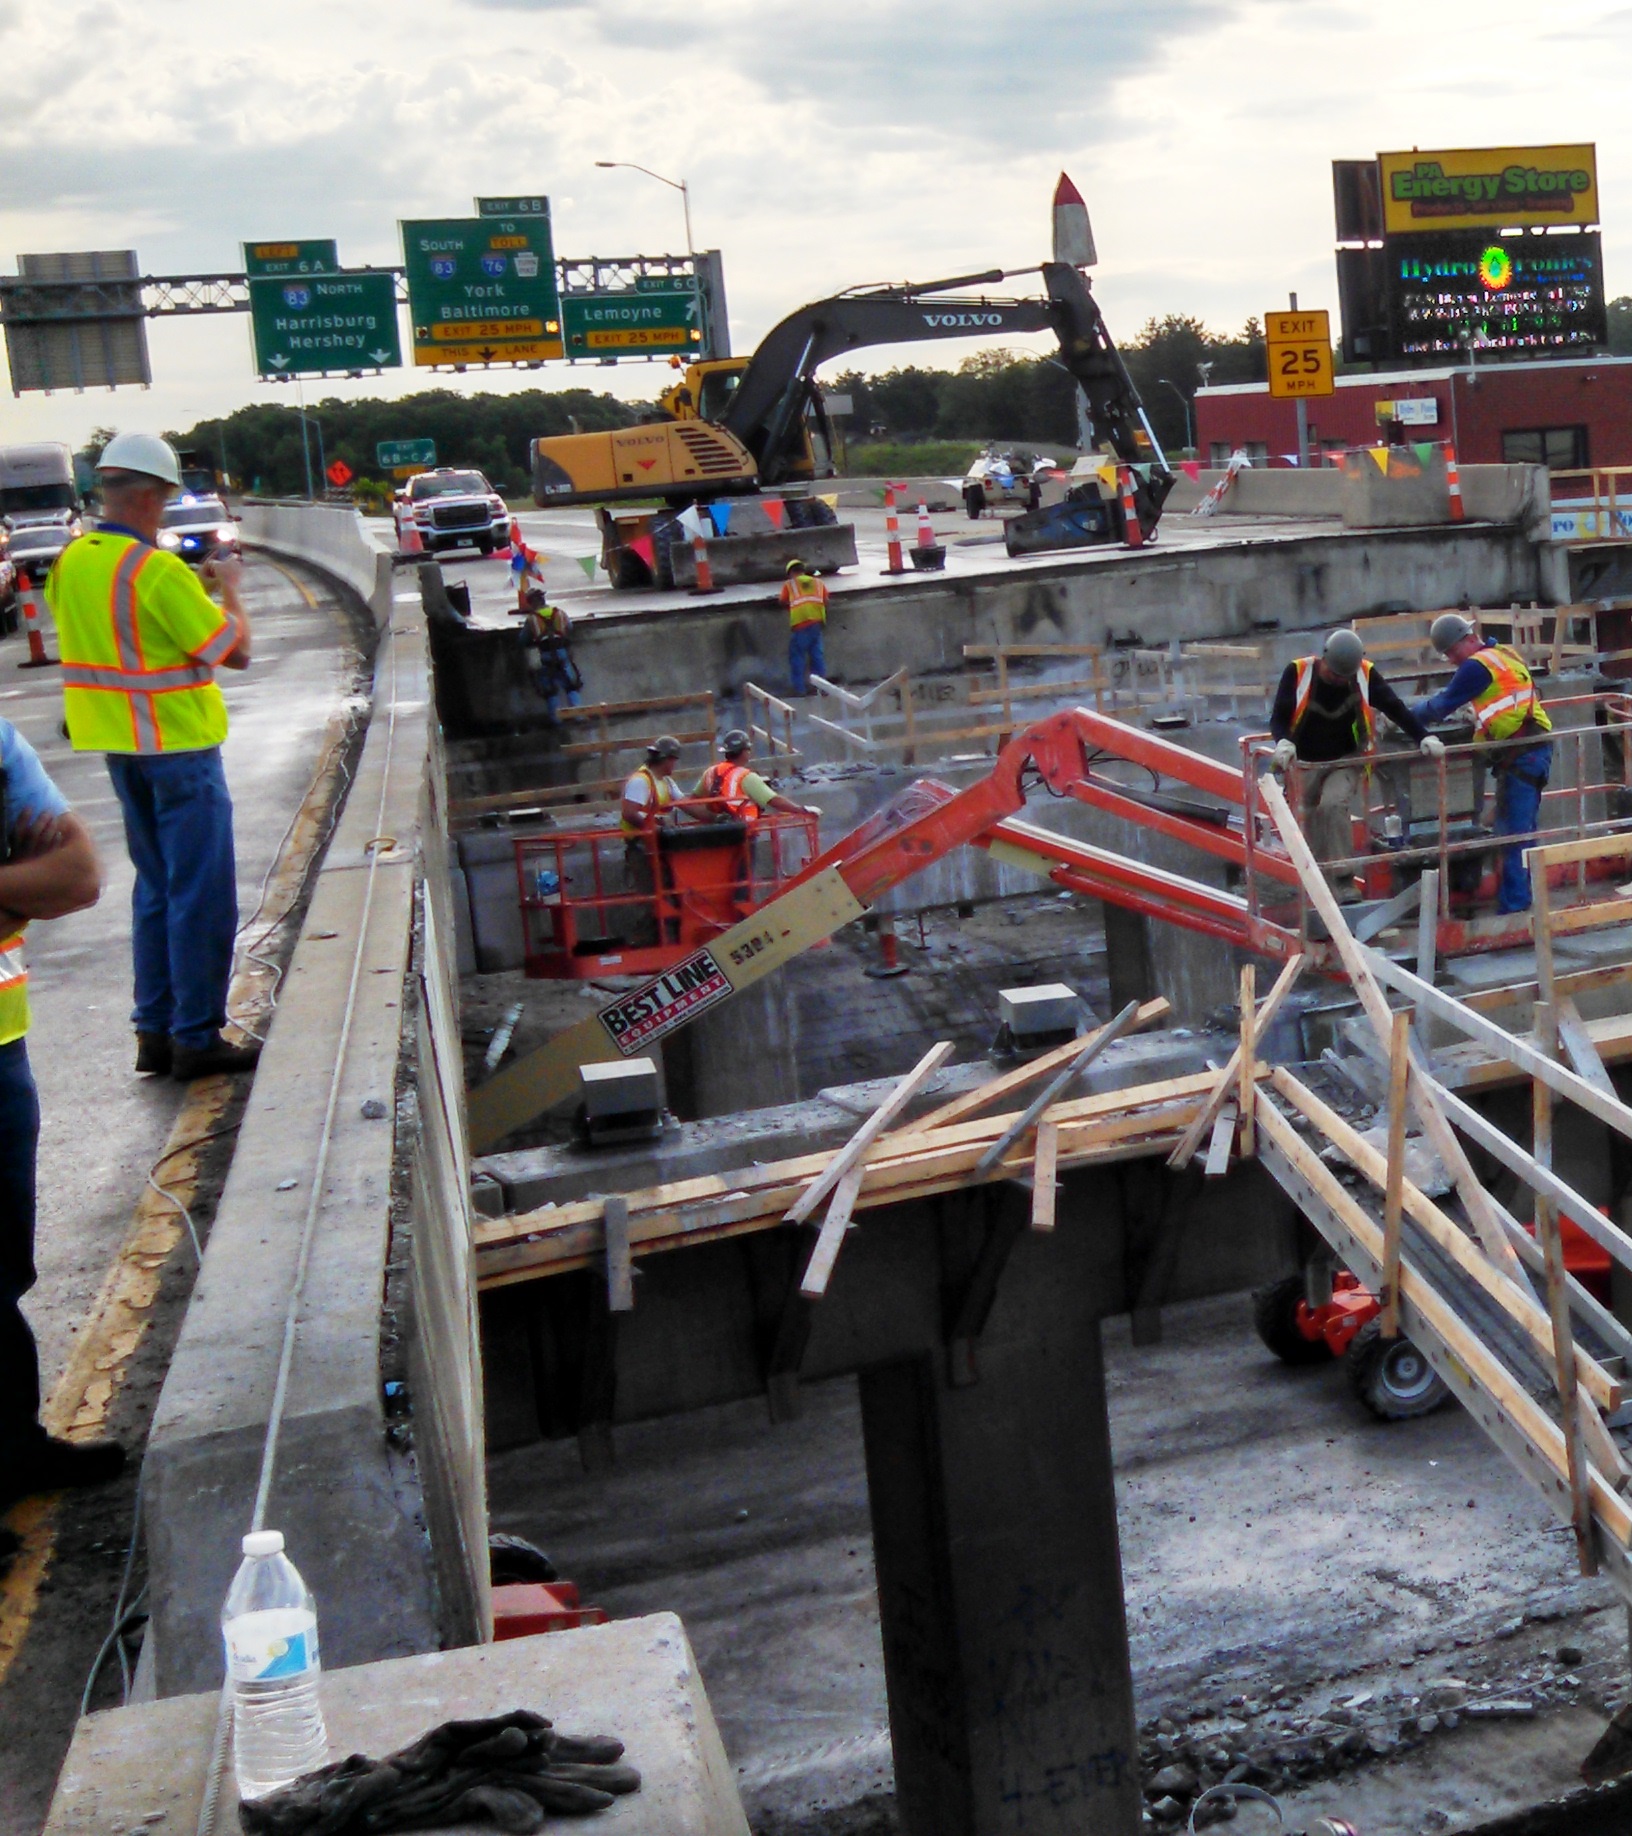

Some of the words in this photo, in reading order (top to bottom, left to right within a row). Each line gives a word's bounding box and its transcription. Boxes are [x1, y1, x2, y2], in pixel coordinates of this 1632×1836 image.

[1417, 164, 1440, 177] PA
[1393, 171, 1500, 199] Energy
[1504, 168, 1588, 192] Store
[486, 201, 509, 210] EXIT
[501, 223, 515, 232] TO
[420, 240, 464, 250] SOUTH
[265, 262, 289, 272] EXIT
[434, 263, 453, 274] 83
[485, 261, 503, 272] 76
[316, 284, 363, 295] NORTH
[643, 280, 664, 288] EXIT
[464, 284, 505, 298] York
[287, 292, 308, 305] 83
[441, 304, 530, 319] Baltimore
[584, 306, 662, 322] Lemoyne
[276, 315, 376, 330] Harrisburg
[922, 313, 1003, 328] VOLVO
[1280, 320, 1315, 334] EXIT
[444, 326, 471, 337] EXIT
[479, 324, 499, 335] 25
[505, 324, 532, 334] MPH
[290, 334, 365, 348] Hershey
[594, 334, 621, 344] EXIT
[628, 332, 648, 343] 25
[653, 331, 680, 340] MPH
[441, 348, 469, 357] THIS
[506, 344, 537, 354] LANE
[1281, 349, 1321, 375] 25
[1286, 380, 1316, 391] MPH
[616, 435, 665, 448] VOLVO
[602, 985, 659, 1035] BEST
[660, 955, 718, 1000] LINE
[618, 977, 725, 1047] EQUIPMENT
